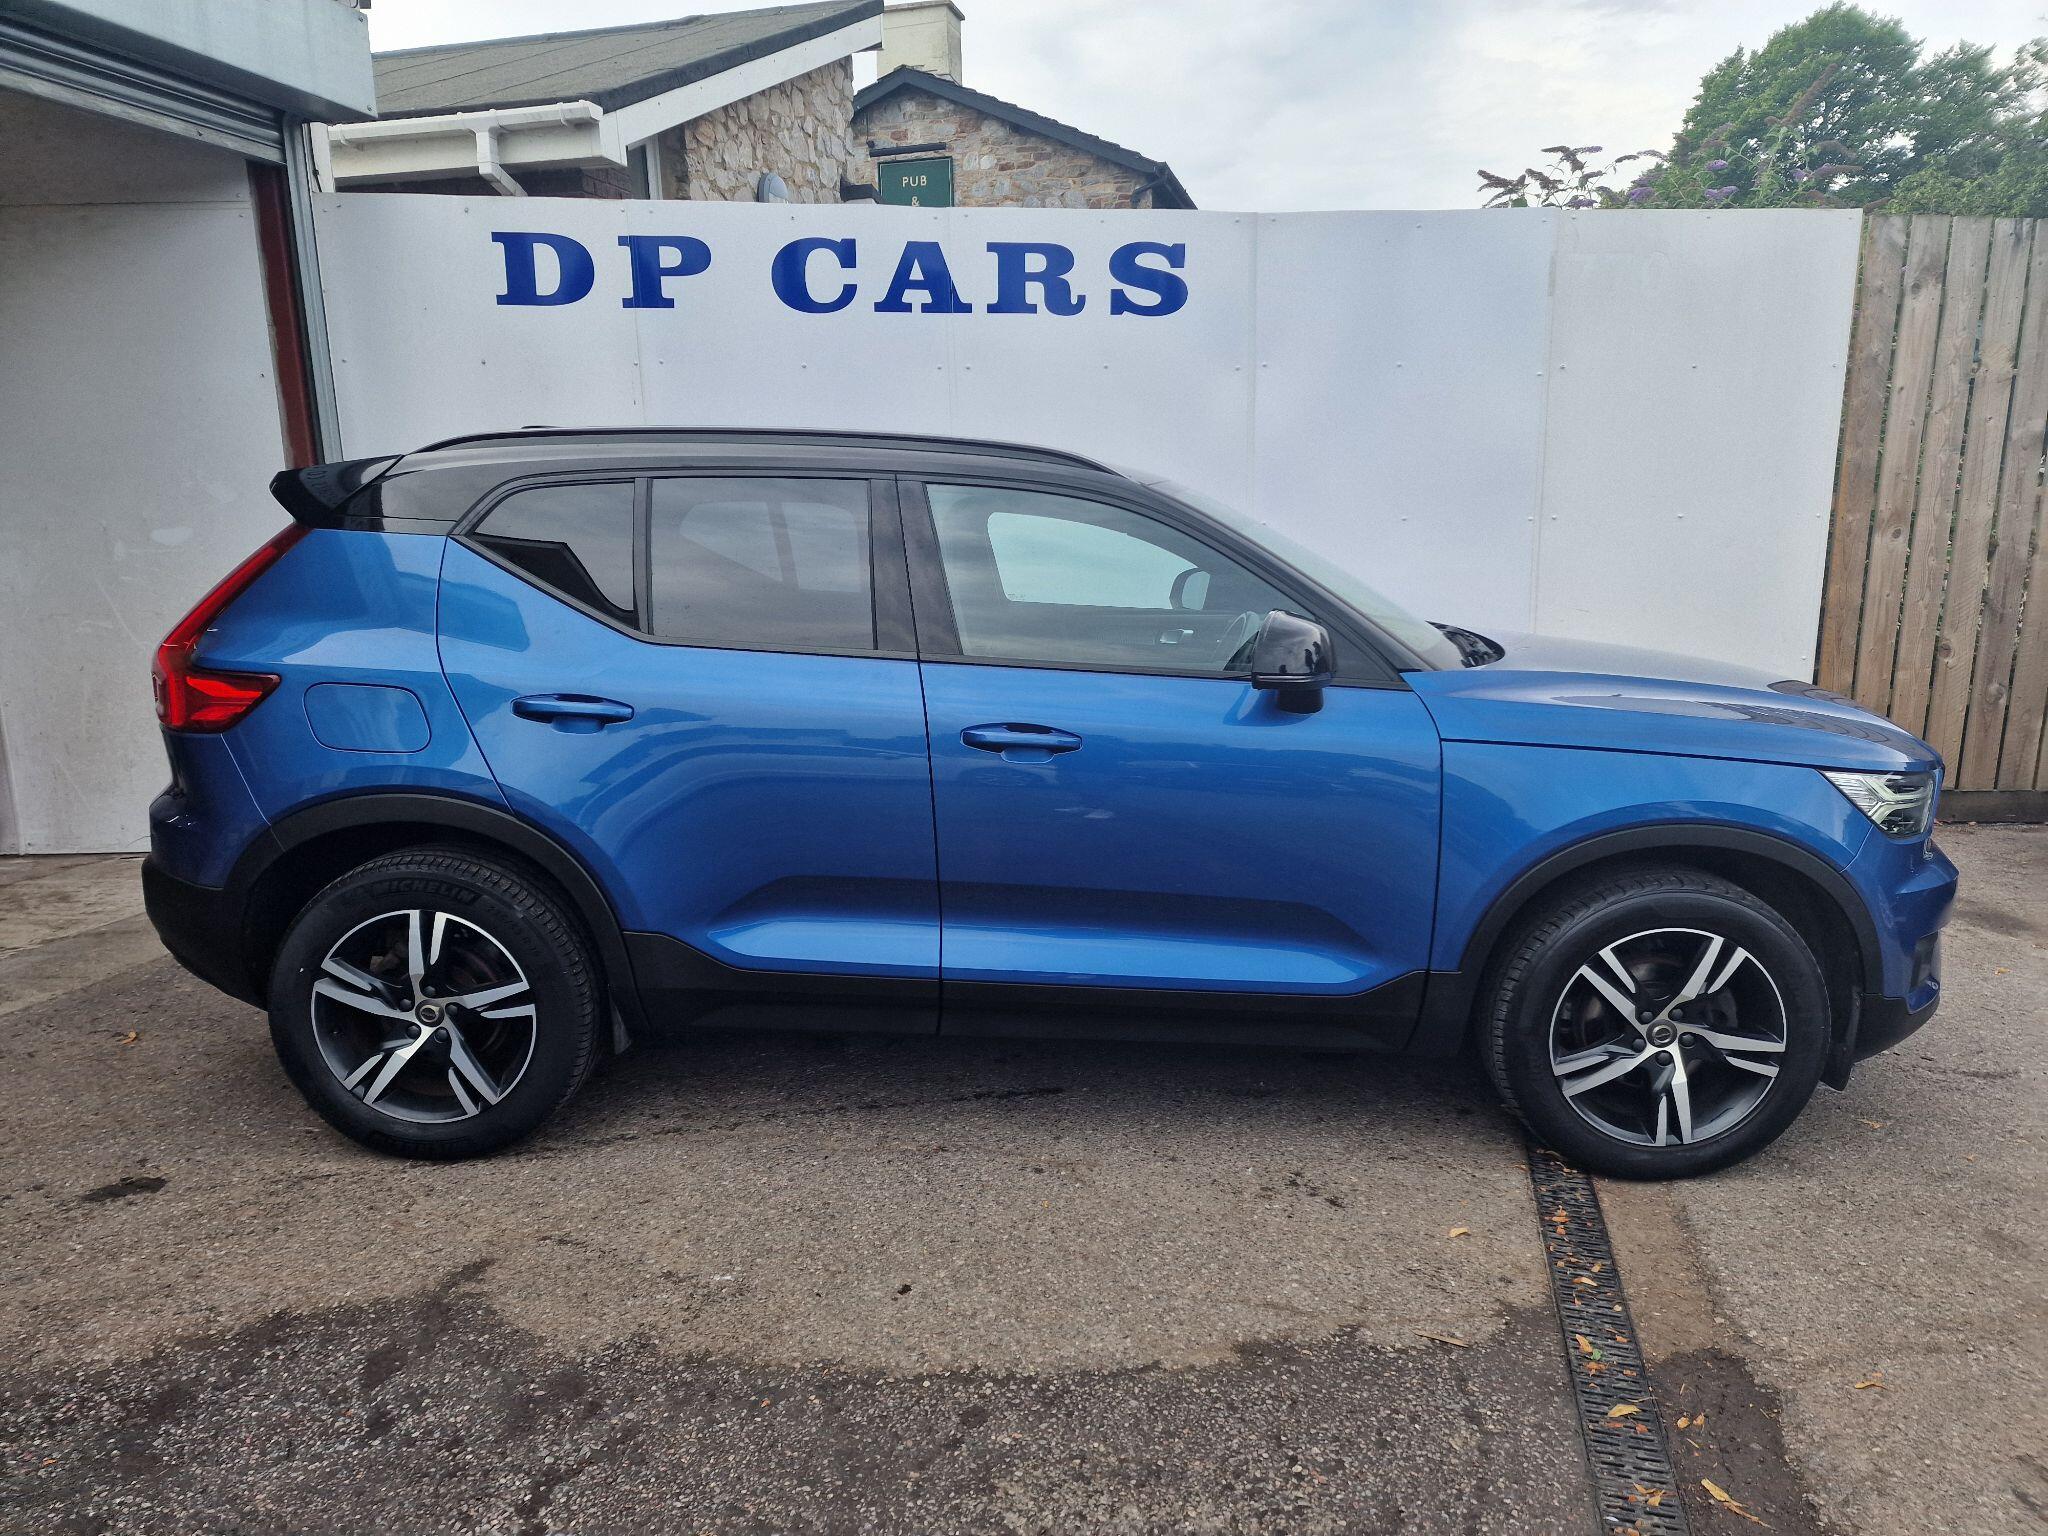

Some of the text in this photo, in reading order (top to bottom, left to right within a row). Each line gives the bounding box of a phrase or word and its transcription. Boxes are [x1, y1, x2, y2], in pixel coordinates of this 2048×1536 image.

[902, 175, 927, 187] PUB
[911, 196, 920, 207] &
[492, 232, 1189, 316] DP CARS
